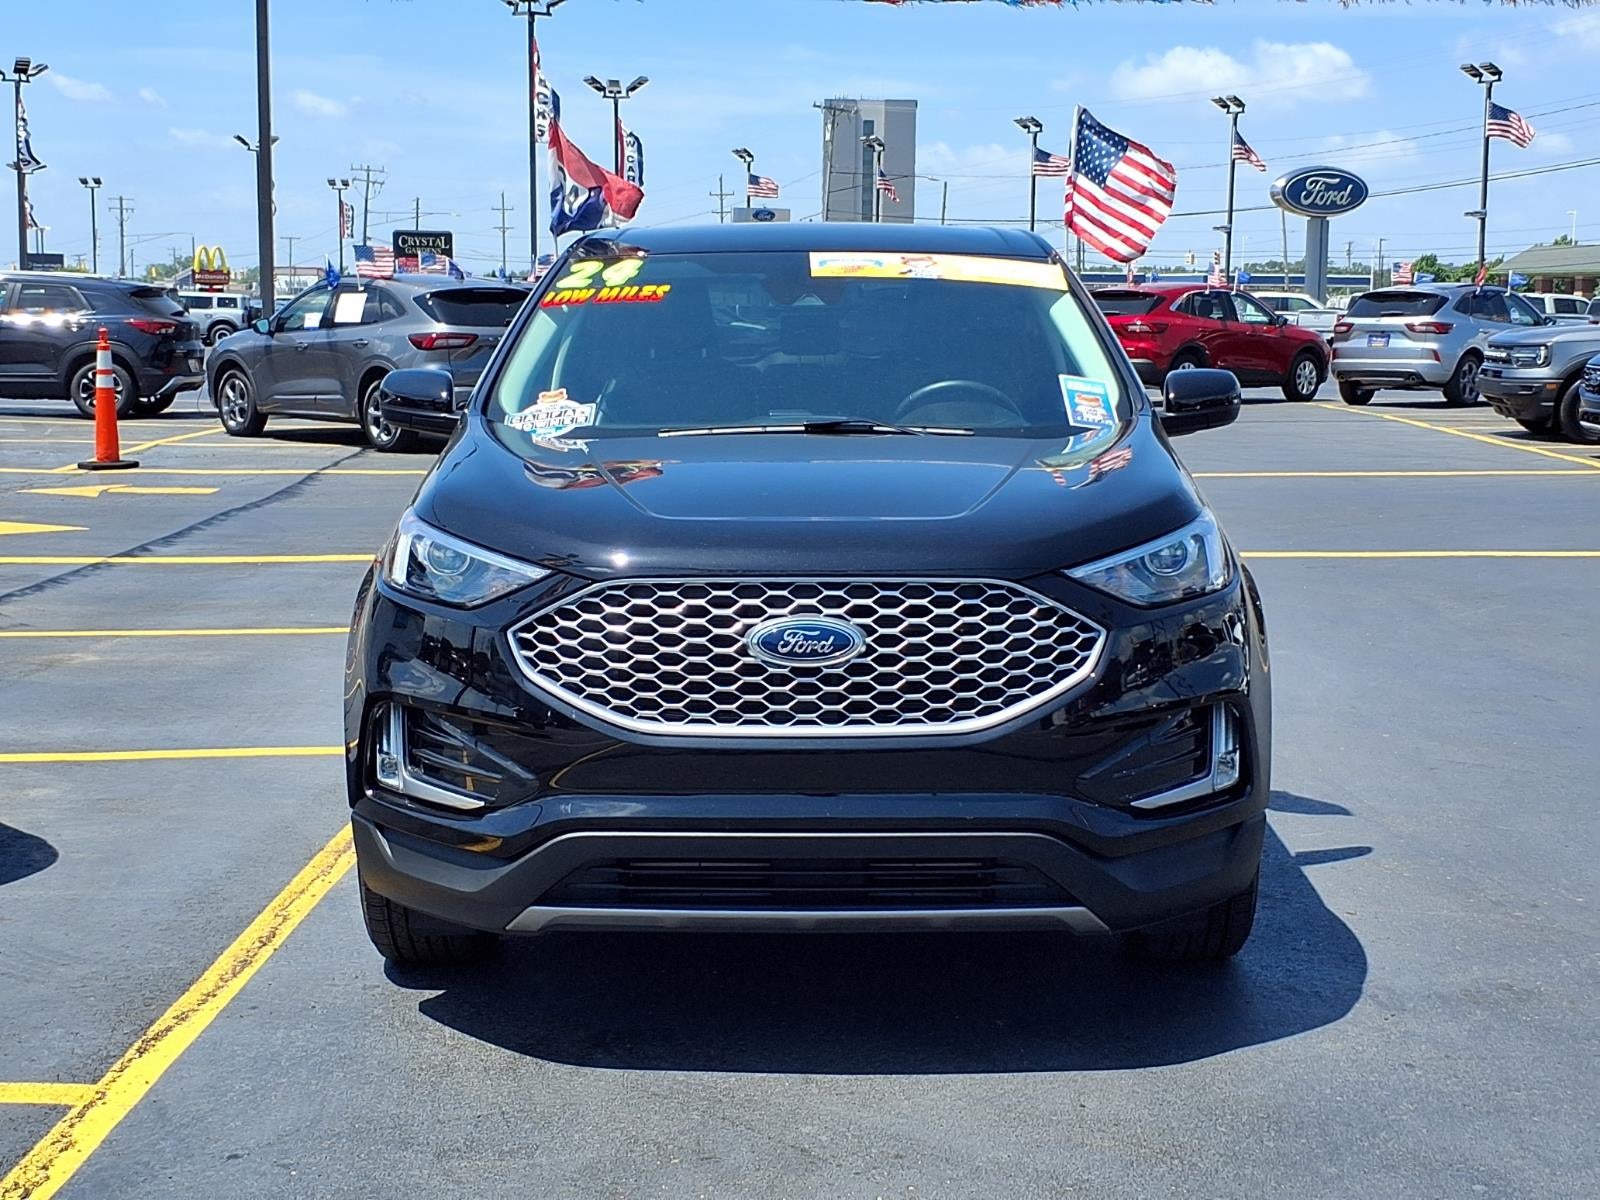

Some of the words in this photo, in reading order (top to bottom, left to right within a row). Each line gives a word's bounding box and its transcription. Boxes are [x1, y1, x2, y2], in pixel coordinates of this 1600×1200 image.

[1300, 176, 1353, 206] Ford
[398, 235, 450, 249] CRYSTAL
[555, 258, 644, 288] 24
[540, 288, 597, 309] LOW
[592, 284, 671, 305] MILES
[777, 629, 835, 654] Ford
